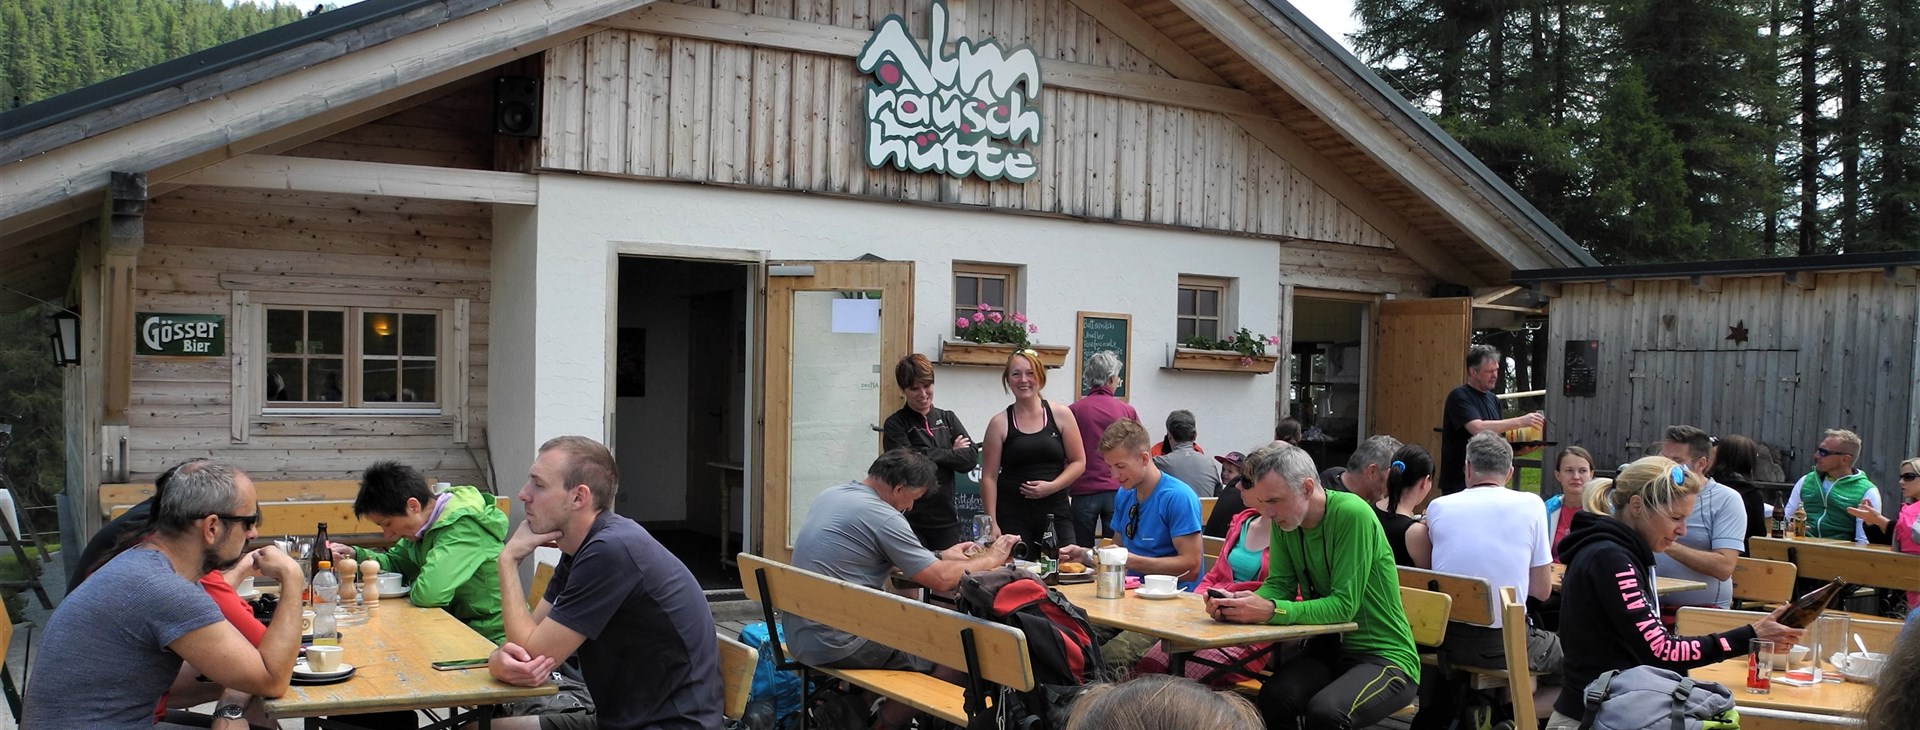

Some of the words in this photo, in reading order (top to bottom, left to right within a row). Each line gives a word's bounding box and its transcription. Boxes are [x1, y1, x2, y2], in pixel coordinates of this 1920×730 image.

[868, 88, 1040, 143] rausch
[869, 121, 1037, 179] hütte
[142, 316, 219, 351] Gösser
[183, 339, 211, 352] Bier
[1615, 563, 1646, 610] ATHL.
